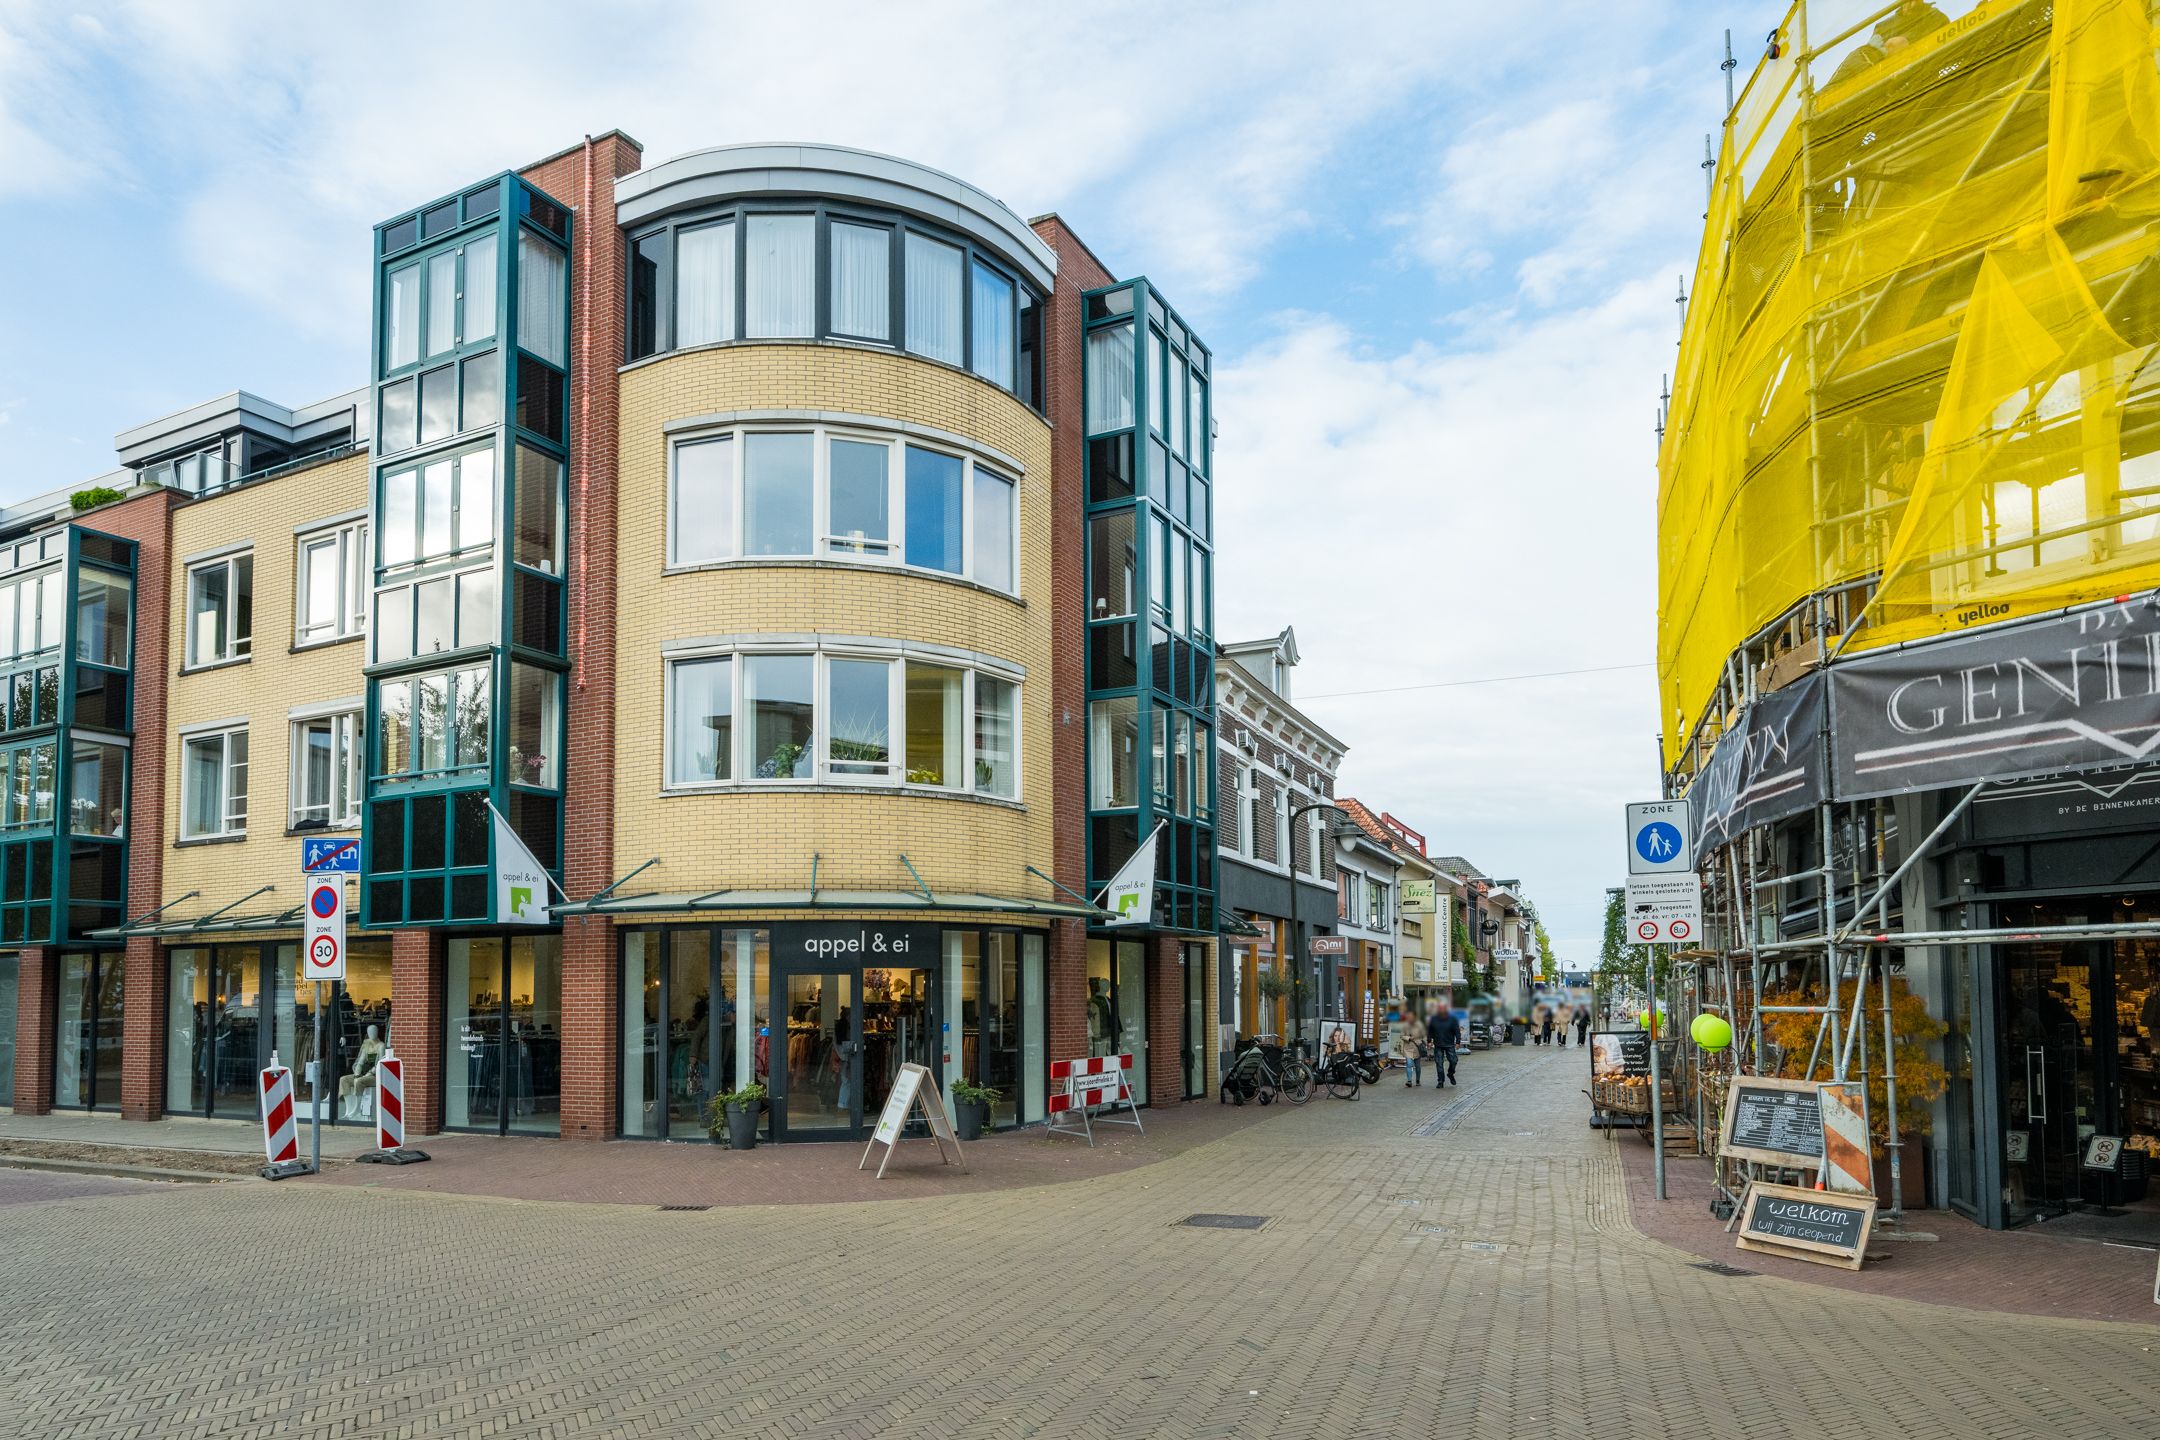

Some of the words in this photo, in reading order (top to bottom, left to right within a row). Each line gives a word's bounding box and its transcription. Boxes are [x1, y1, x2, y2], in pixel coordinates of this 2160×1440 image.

[1936, 10, 1987, 44] yelloo
[1958, 603, 2010, 626] yelloo
[1642, 805, 1674, 814] ZONE
[2058, 807, 2070, 815] BY
[502, 872, 523, 883] appel
[524, 872, 531, 881] &
[531, 874, 539, 882] ei
[1114, 881, 1133, 893] appel
[1133, 881, 1139, 889] &
[804, 930, 865, 958] appel
[872, 932, 888, 953] &
[892, 933, 909, 953] ei
[315, 945, 332, 957] 30
[1758, 1219, 1774, 1233] wij
[1776, 1222, 1796, 1236] zijn
